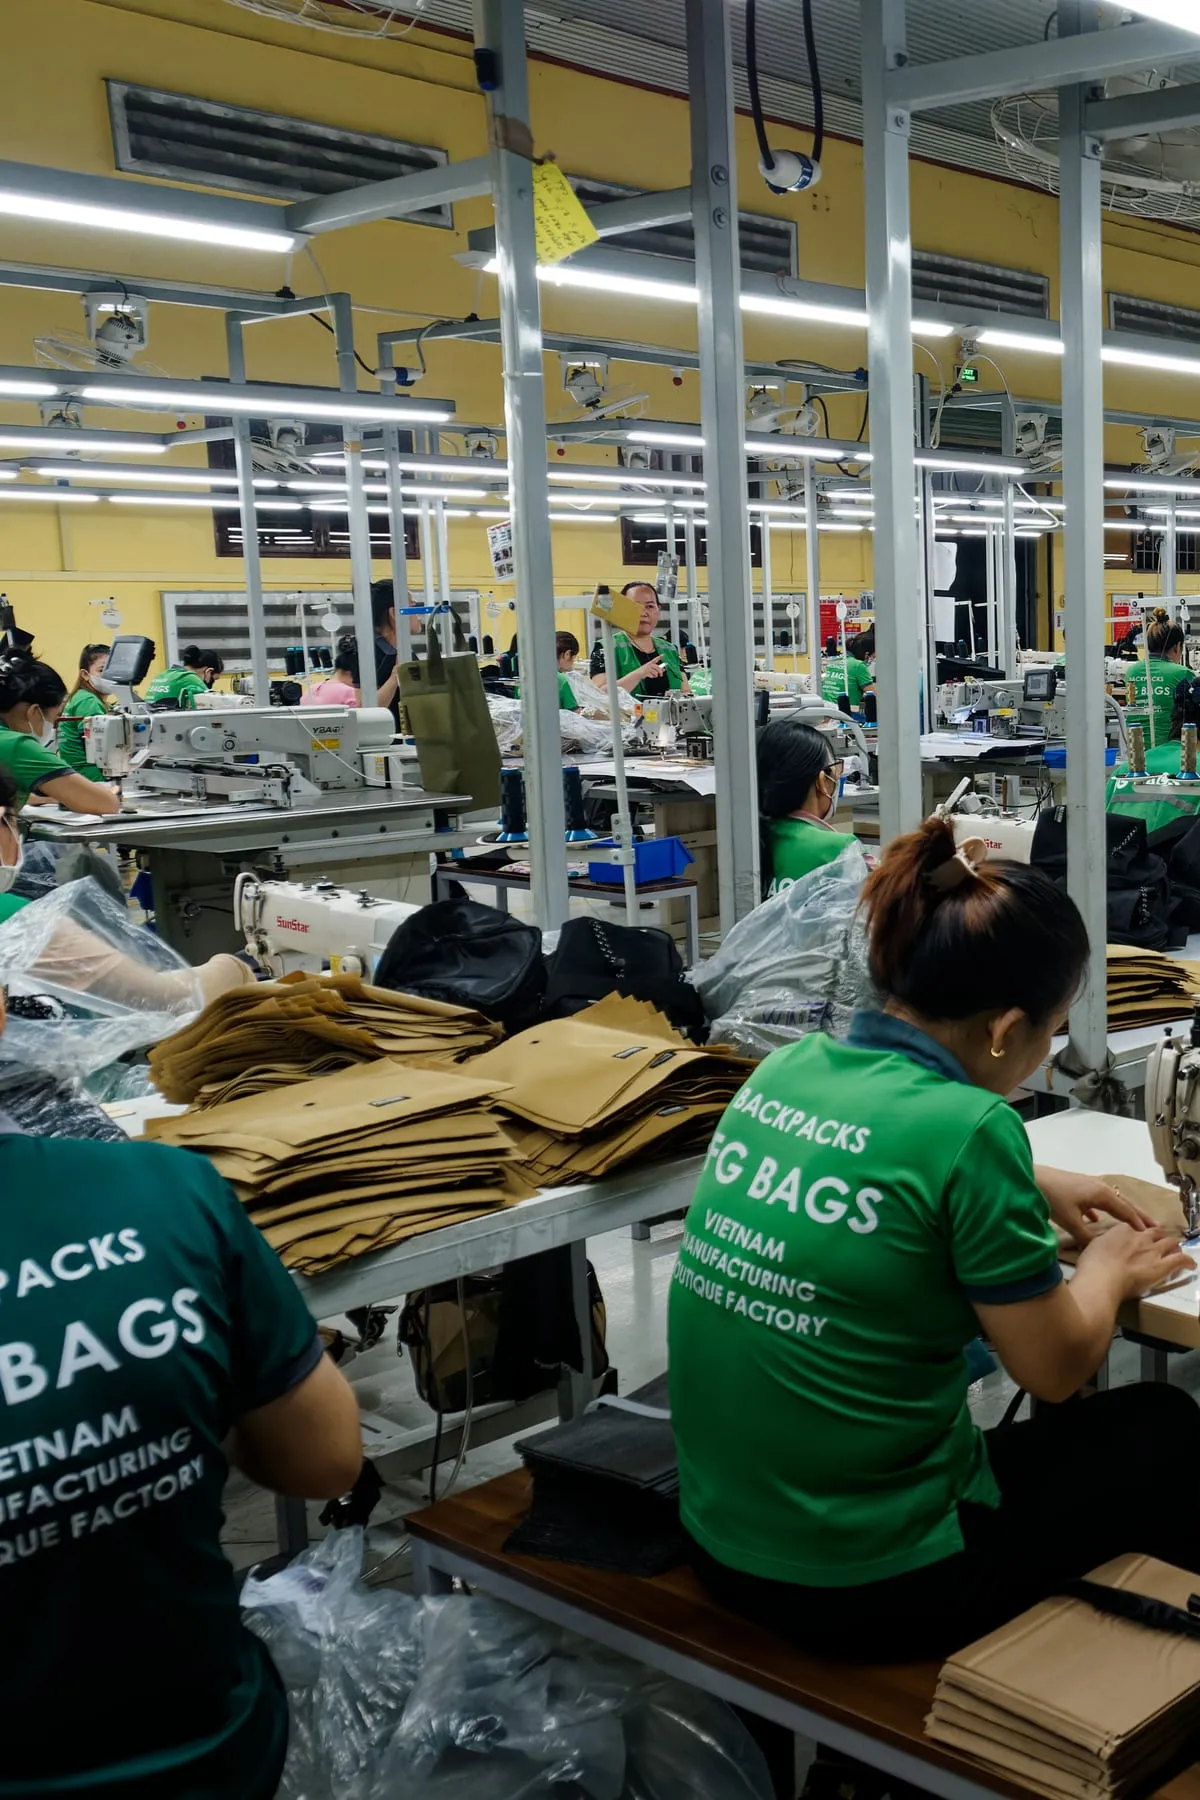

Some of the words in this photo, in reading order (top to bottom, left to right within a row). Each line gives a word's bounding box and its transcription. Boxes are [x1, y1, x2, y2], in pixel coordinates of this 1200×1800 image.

[277, 915, 310, 934] SunStar
[732, 1087, 872, 1154] BACKPACKS
[747, 1155, 884, 1234] BAGS
[682, 1231, 817, 1302] MANUFACTURING
[704, 1208, 786, 1263] VIETNAM
[673, 1260, 725, 1306] OUTIQUE
[725, 1290, 828, 1337] FACTORY
[0, 1287, 206, 1406] BAGS
[70, 1454, 205, 1538] FACTORY
